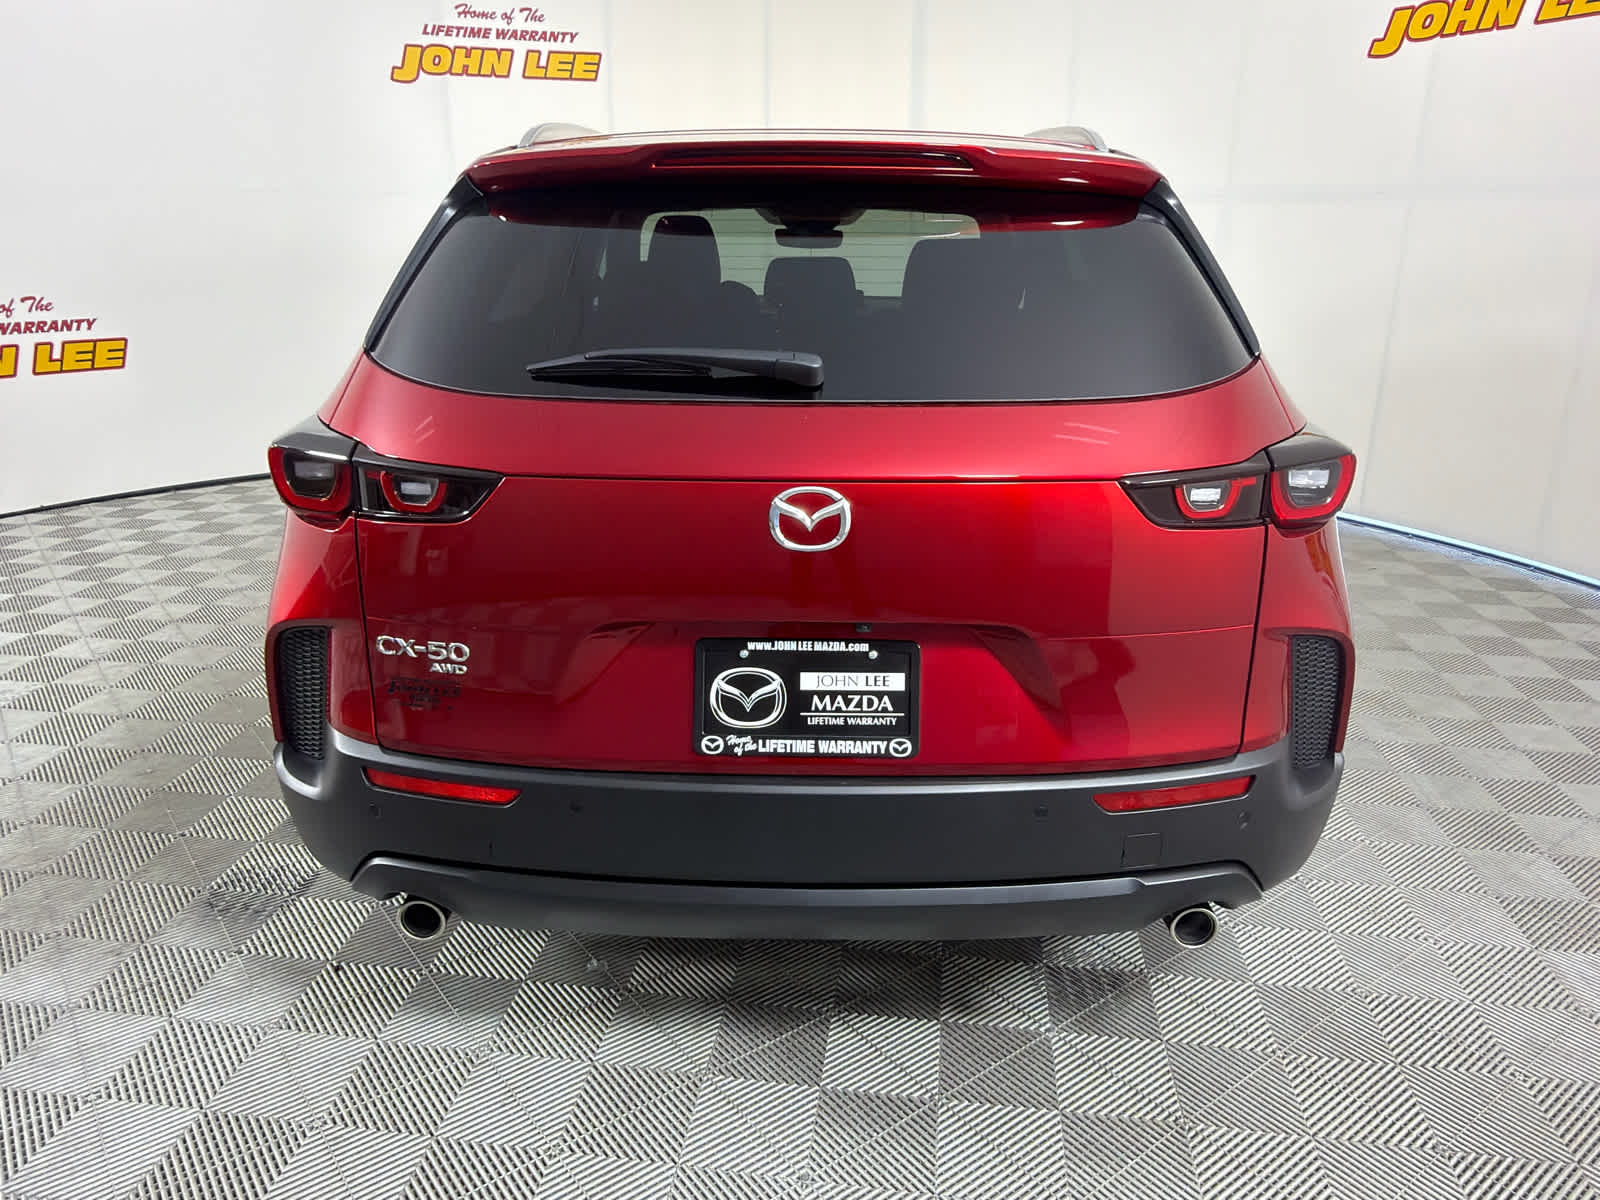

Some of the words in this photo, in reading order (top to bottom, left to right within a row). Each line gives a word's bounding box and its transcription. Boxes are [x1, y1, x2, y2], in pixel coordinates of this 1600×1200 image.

[454, 3, 497, 20] Home
[501, 8, 515, 25] of
[519, 7, 545, 22] The
[421, 24, 492, 40] LIFETIME
[494, 28, 579, 44] WARRANTY
[1367, 0, 1525, 59] JOHN
[390, 43, 514, 84] JOHN
[522, 50, 602, 82] LEE
[20, 296, 54, 313] The
[0, 318, 97, 336] WARRANTY
[32, 337, 128, 376] LEE
[376, 635, 470, 662] CX-50
[798, 641, 813, 651] LEE
[813, 641, 869, 652] MAZDA.com
[429, 662, 468, 675] AWD
[816, 674, 859, 688] JOHN
[865, 675, 890, 687] LEE
[811, 694, 894, 712] MAZDA
[807, 717, 845, 725] LIFETIME
[846, 717, 897, 726] WARRANTY
[758, 739, 815, 753] LIFETIME
[817, 740, 888, 755] WARRANTY
